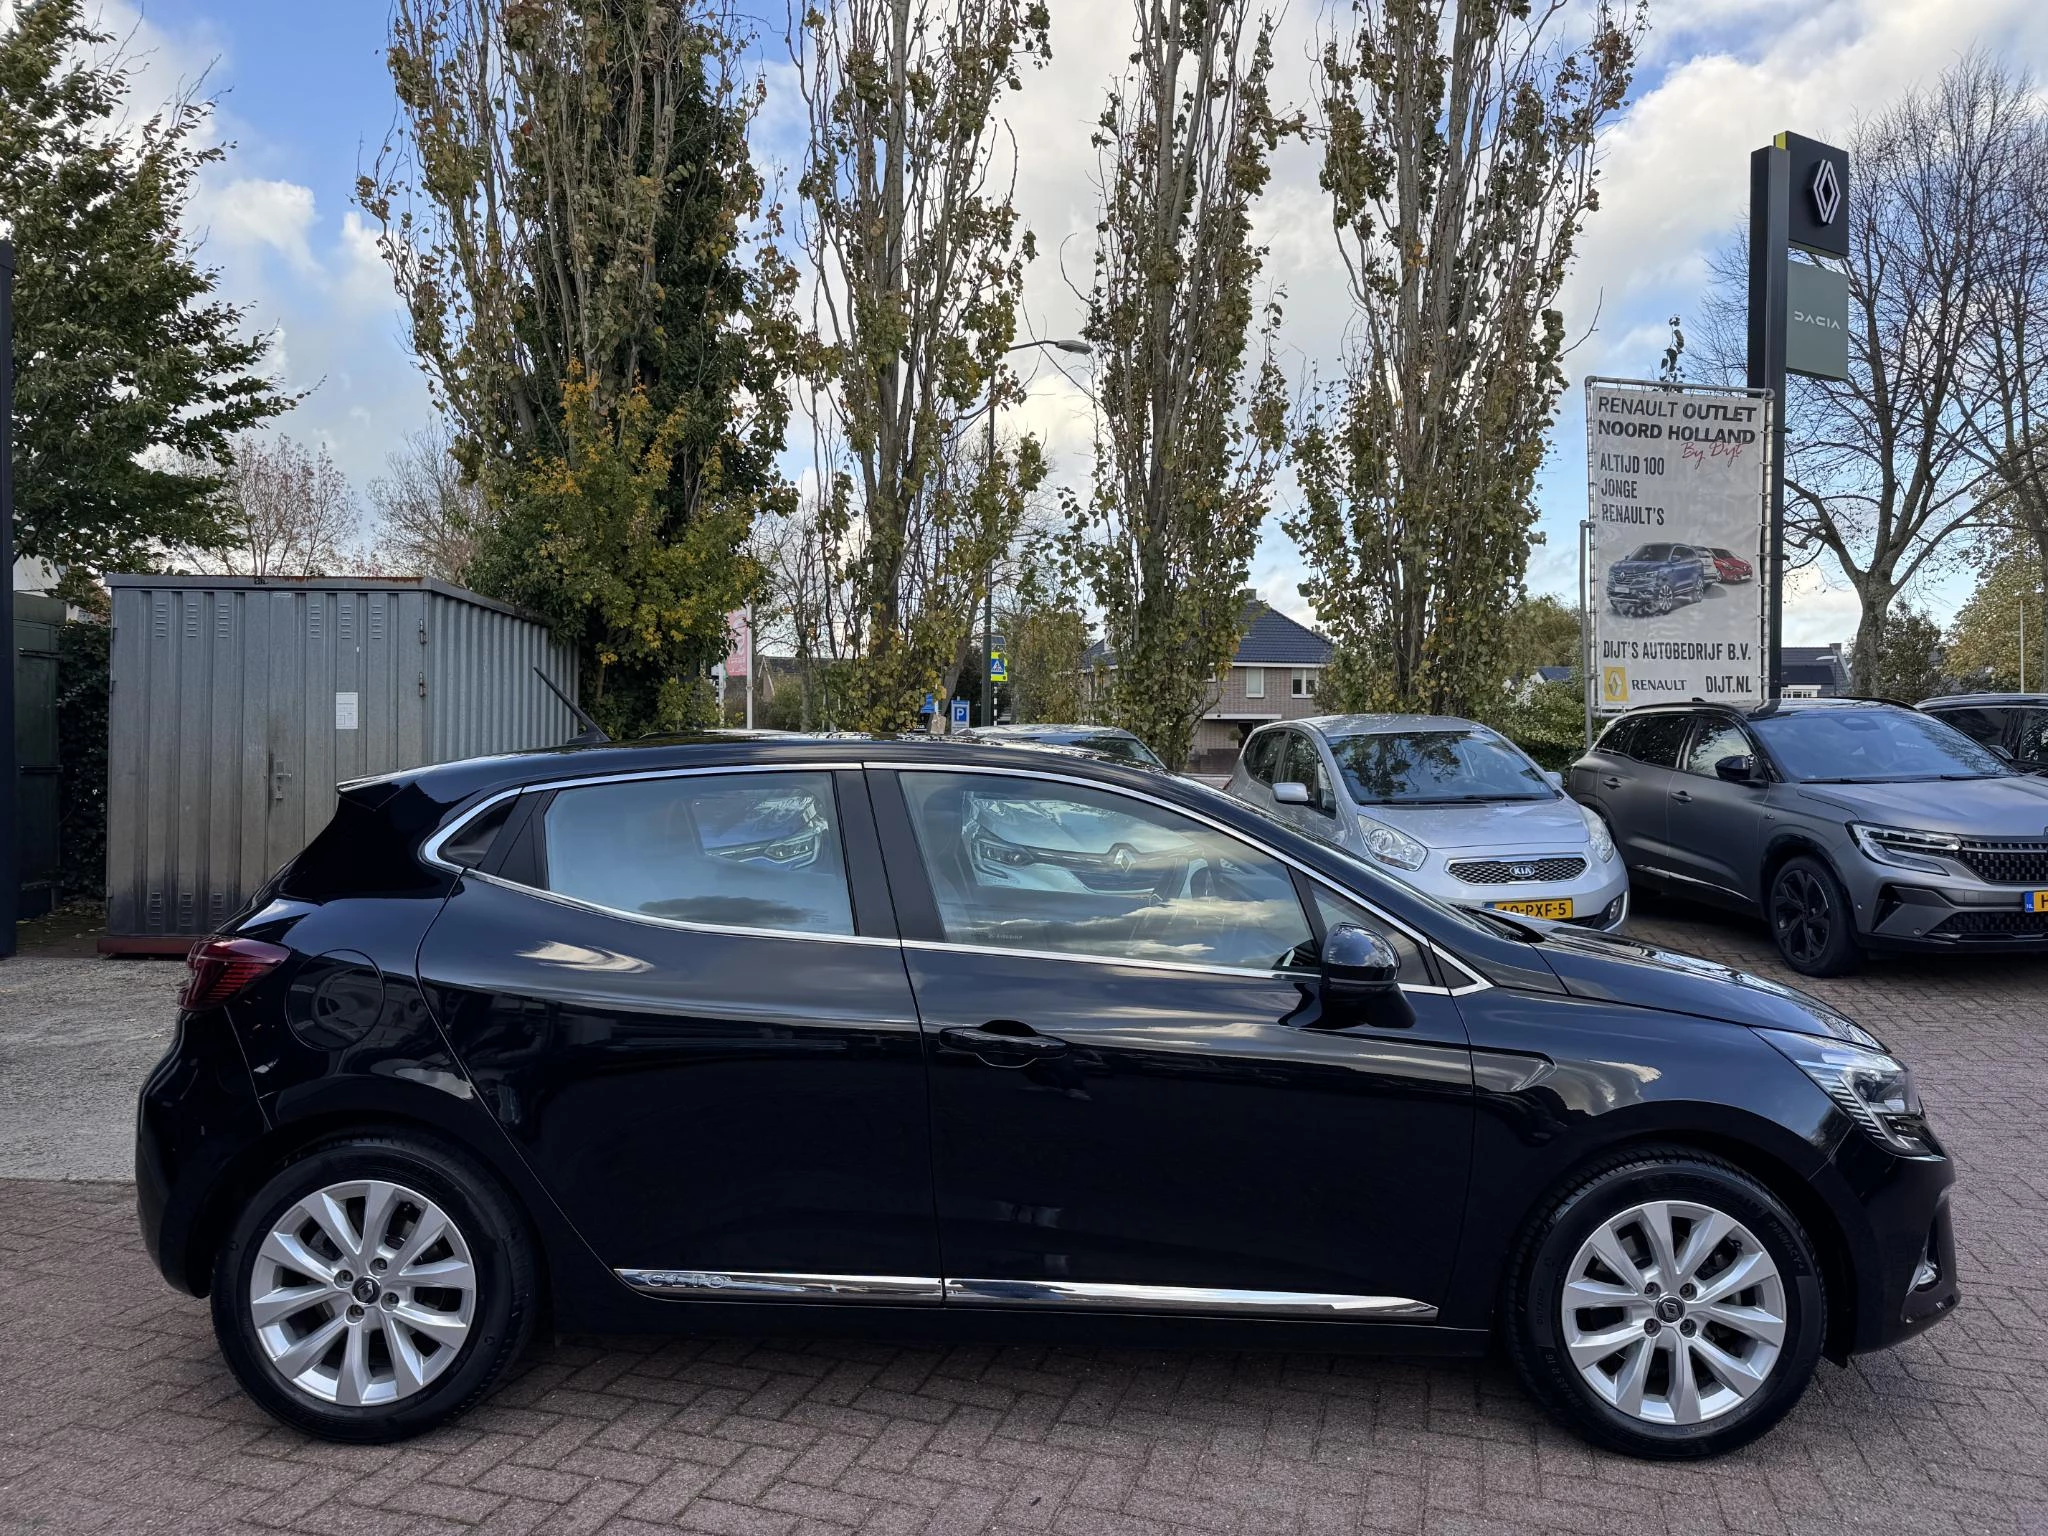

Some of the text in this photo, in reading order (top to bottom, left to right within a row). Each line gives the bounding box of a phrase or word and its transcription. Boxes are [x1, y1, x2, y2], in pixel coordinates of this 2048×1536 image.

[1794, 311, 1841, 330] DACIA
[1598, 396, 1757, 423] RENAULT OUTLET
[1598, 419, 1756, 445] NOORD HOLLAND
[1600, 453, 1665, 476] ALTIJD 100
[1680, 441, 1706, 470] By
[1601, 478, 1638, 499] JONGE
[1601, 503, 1665, 526] RENAULT'S
[1603, 640, 1752, 661] DIJT'S AUTOBEDRIJF B.V.
[1631, 675, 1753, 693] RENAULT DIJT.NL
[956, 708, 965, 721] P
[647, 1273, 725, 1289] CLIO
